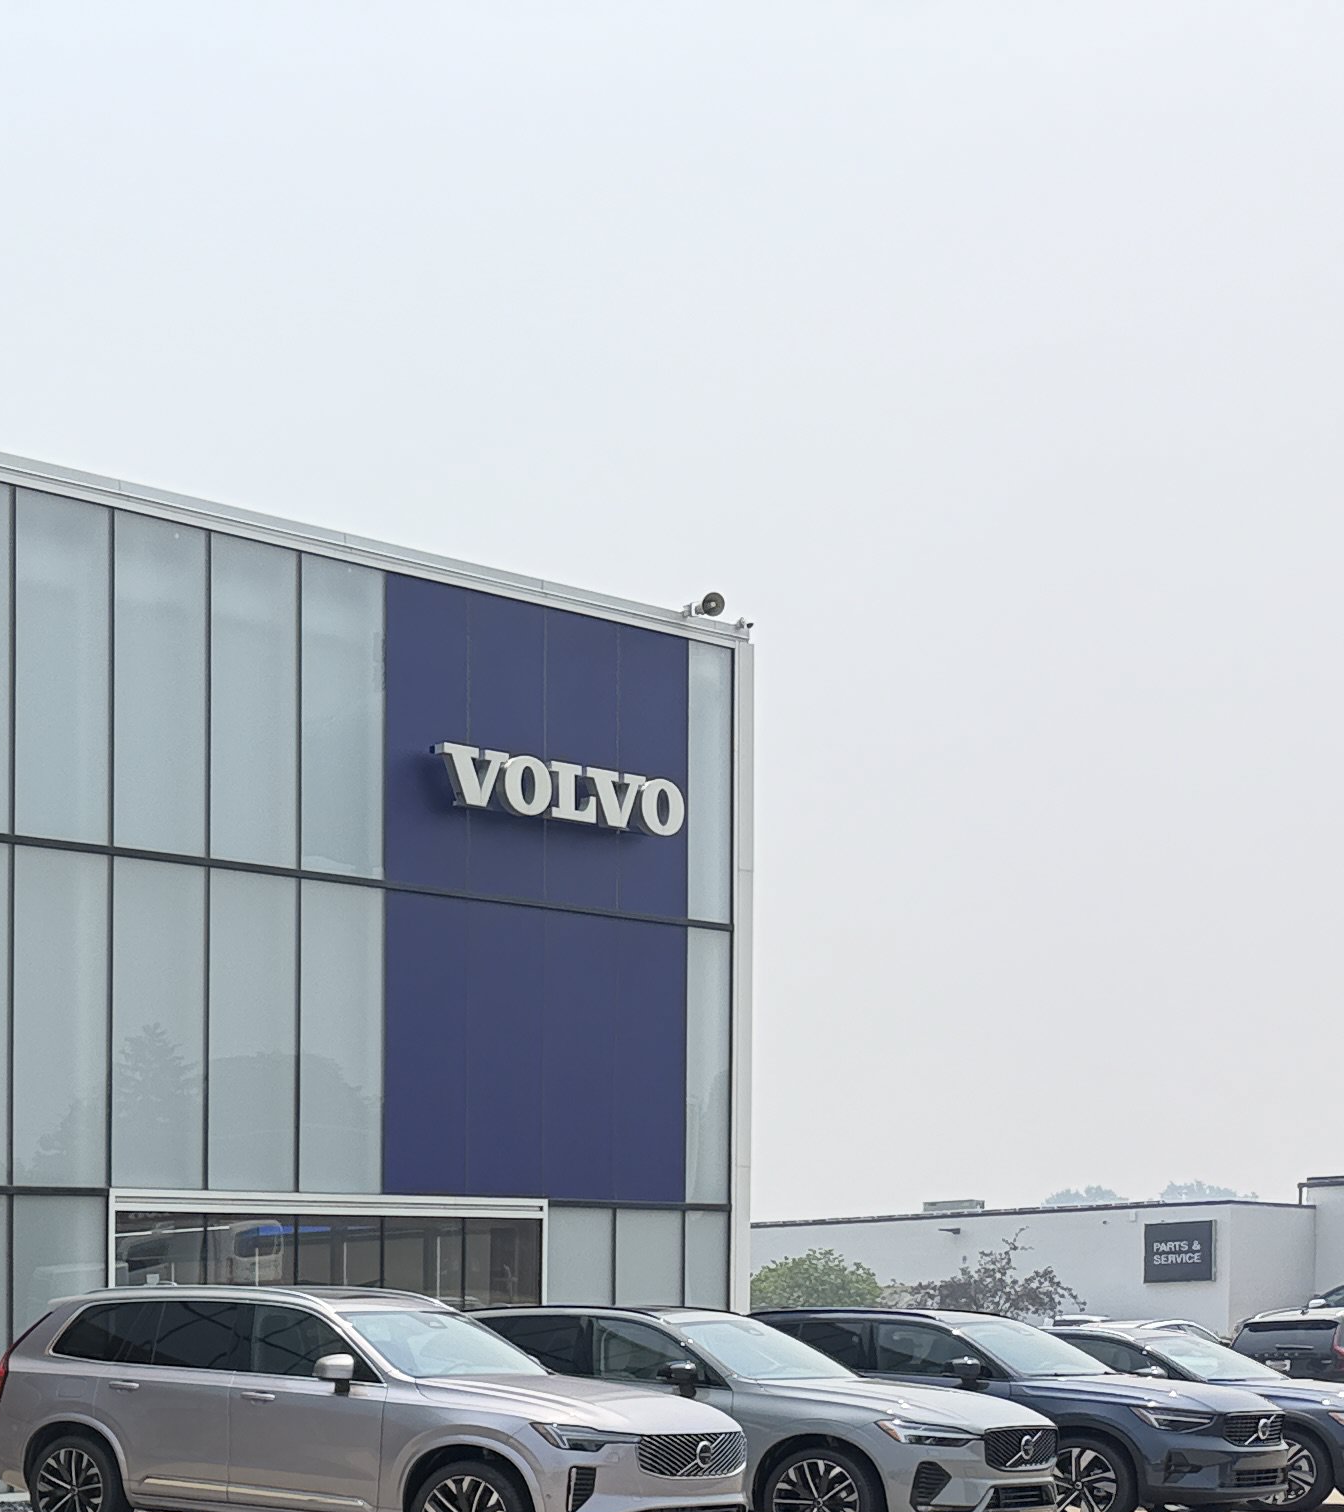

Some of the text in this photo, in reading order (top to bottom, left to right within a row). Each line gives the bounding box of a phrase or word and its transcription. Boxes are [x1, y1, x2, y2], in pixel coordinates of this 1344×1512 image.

[438, 741, 686, 837] VOLVO
[1153, 1240, 1201, 1253] PARTS &
[1153, 1253, 1202, 1265] SERVICE
